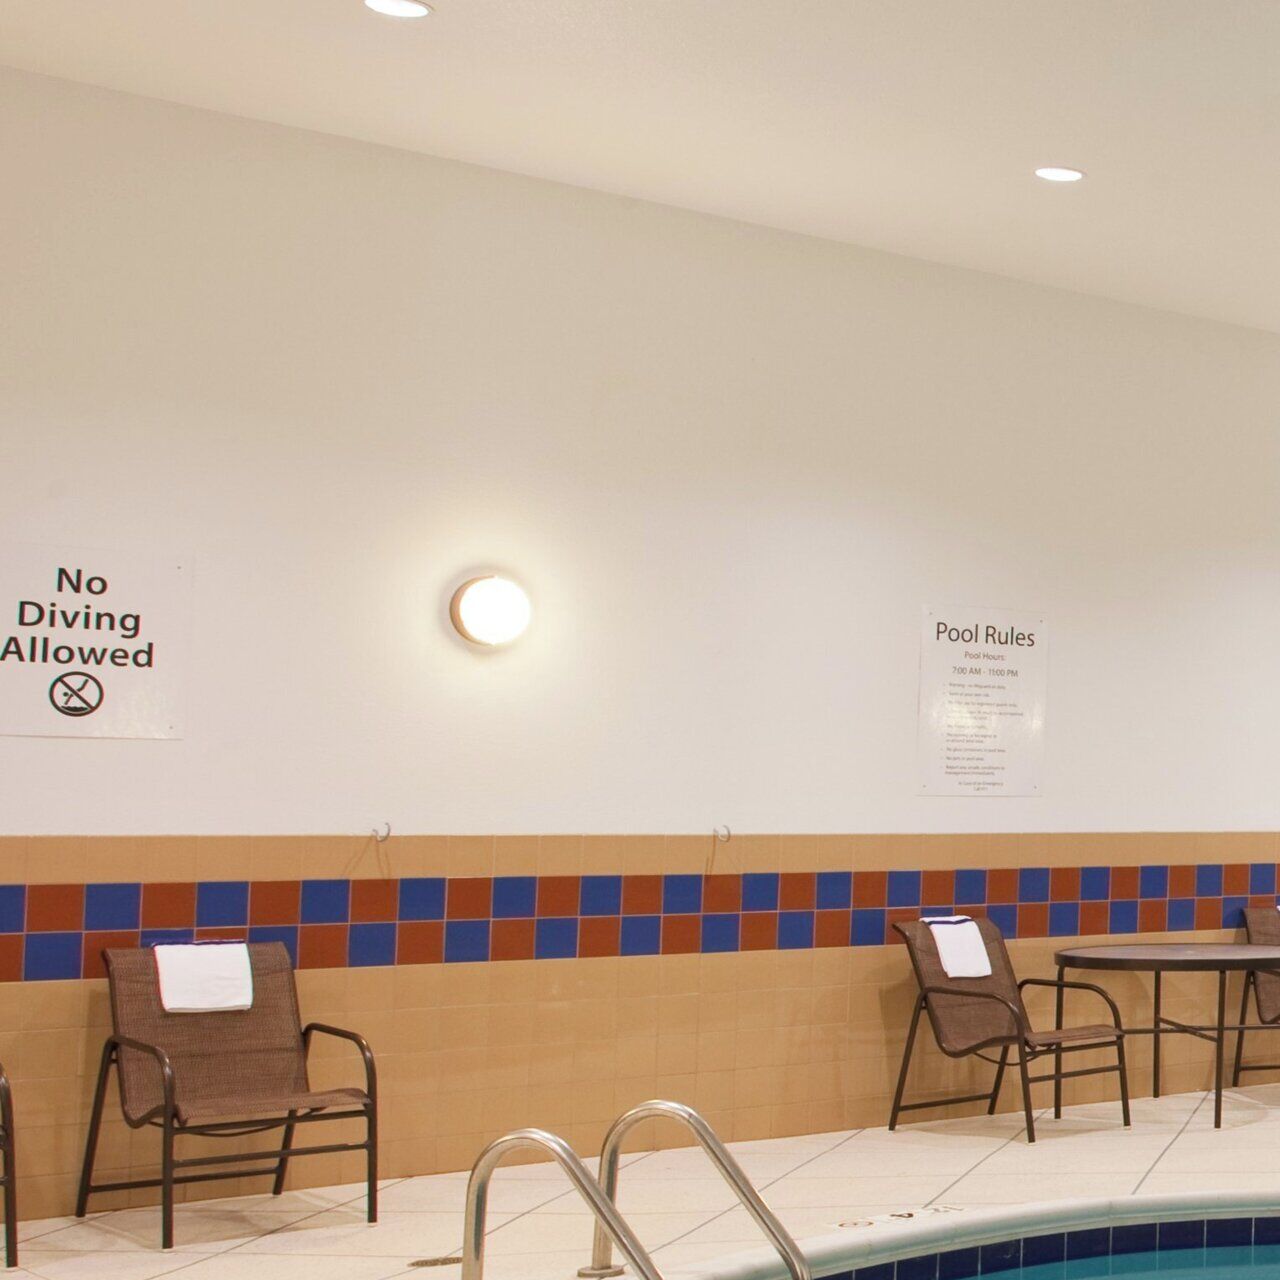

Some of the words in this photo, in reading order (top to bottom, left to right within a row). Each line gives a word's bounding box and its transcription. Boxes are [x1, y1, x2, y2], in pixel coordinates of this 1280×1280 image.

[57, 567, 108, 595] No
[18, 600, 141, 639] Diving
[936, 621, 978, 643] Pool
[985, 625, 1035, 647] Rules
[0, 636, 154, 668] Allowed
[964, 651, 981, 660] Pool
[969, 667, 982, 676] AM
[1006, 669, 1019, 678] PM
